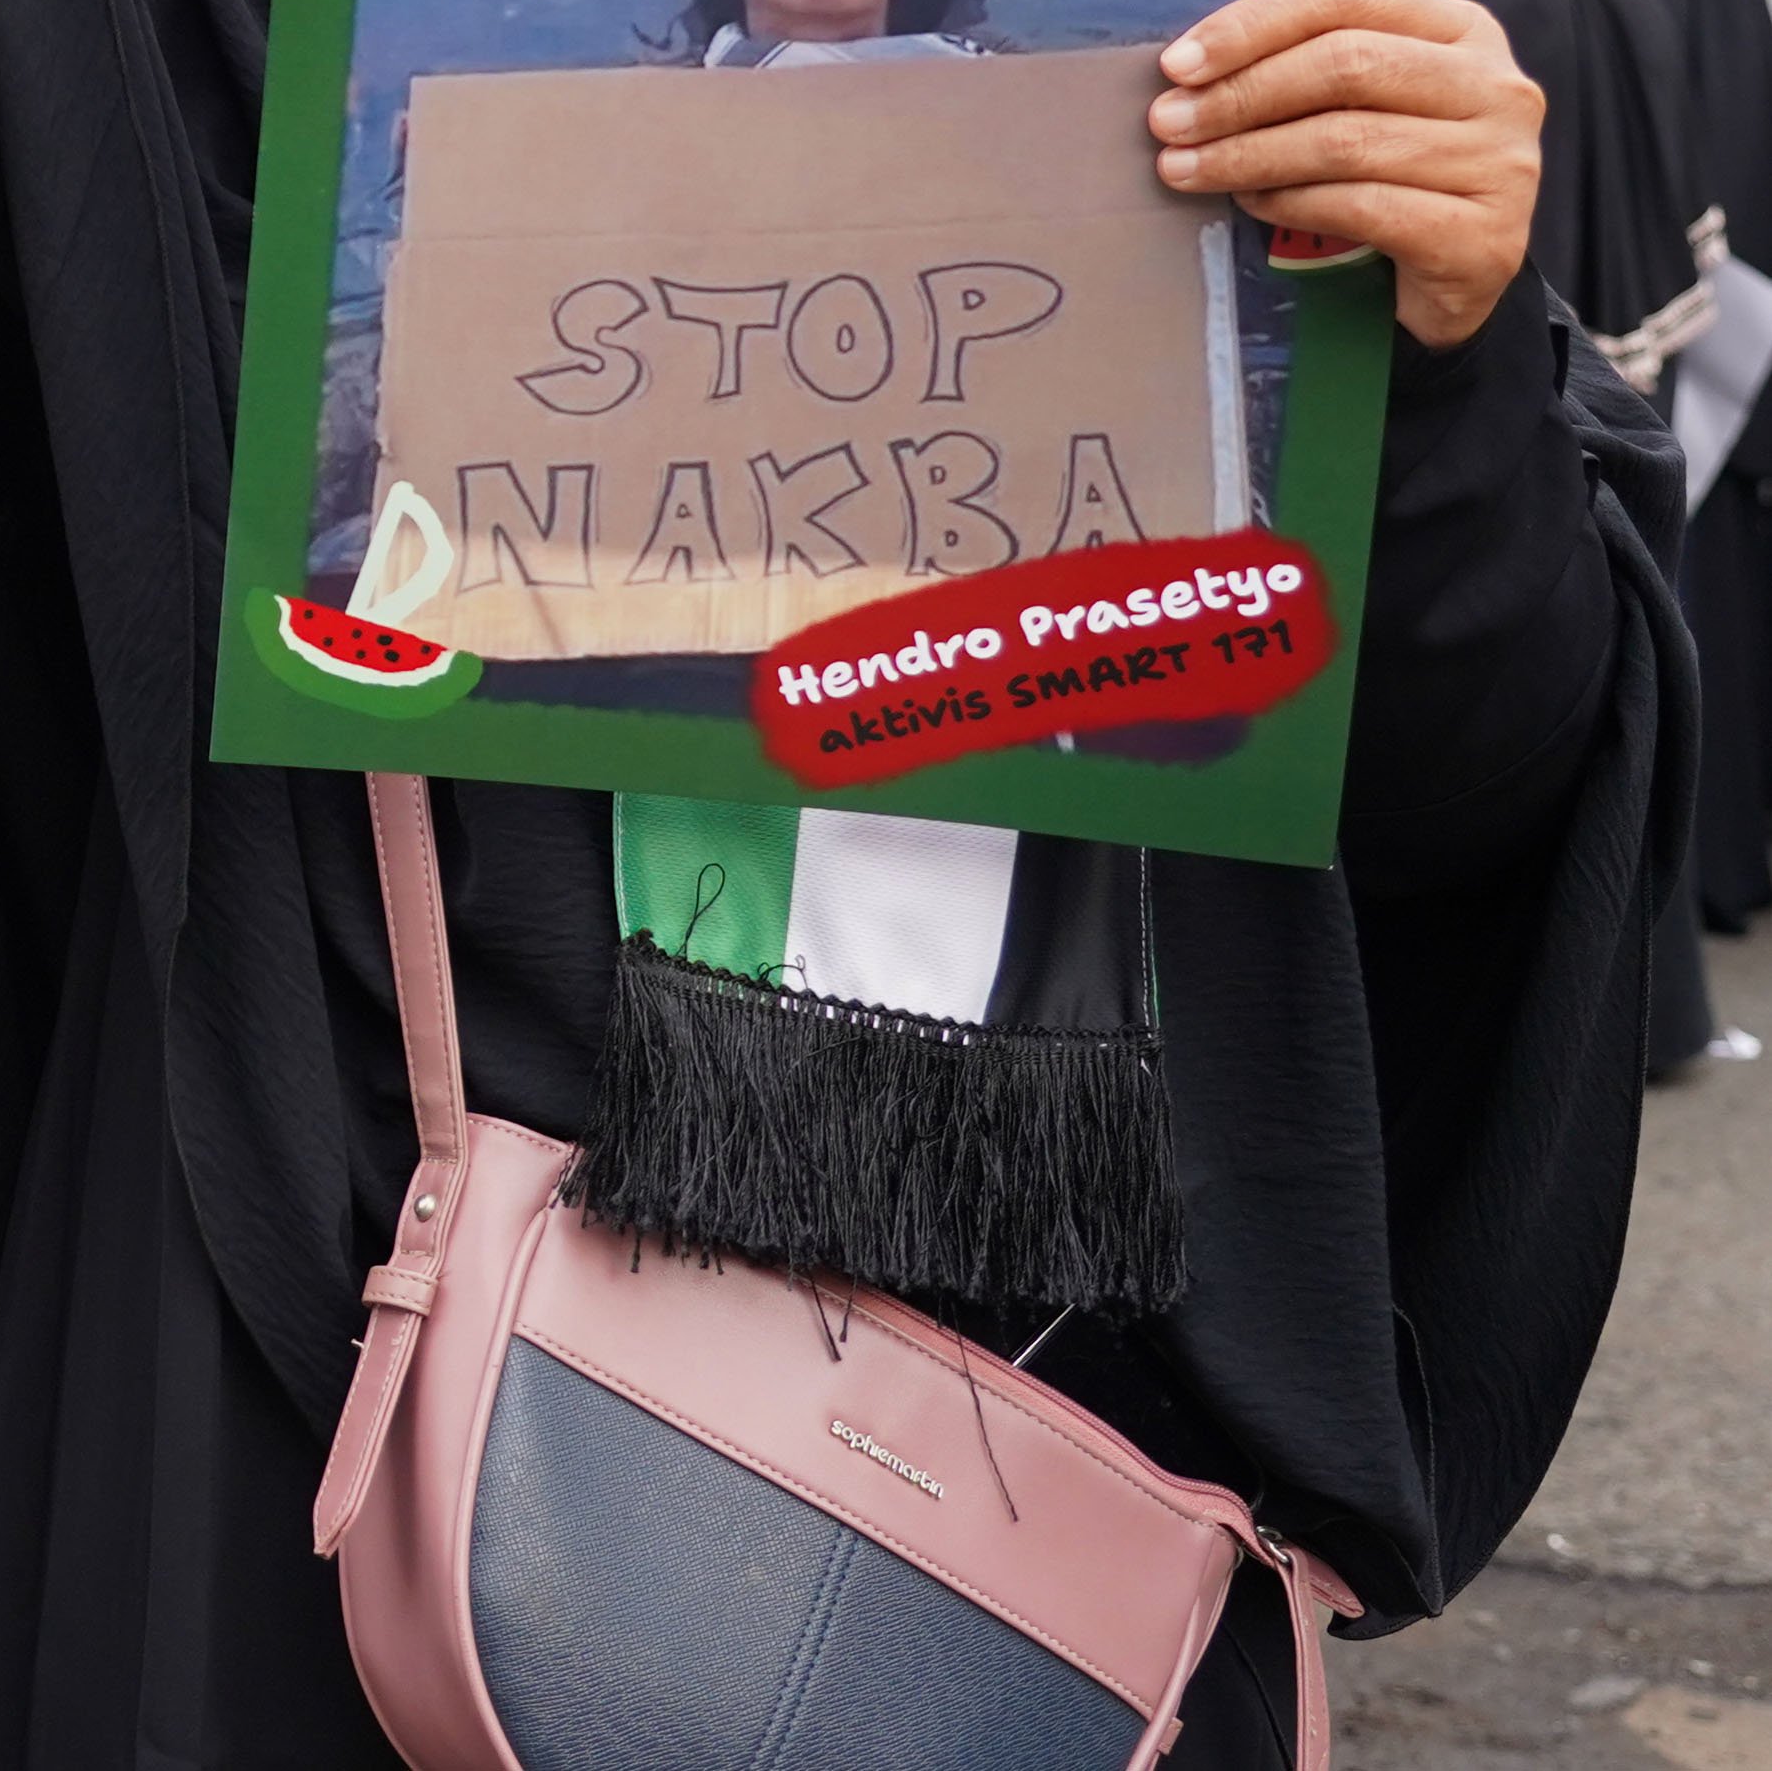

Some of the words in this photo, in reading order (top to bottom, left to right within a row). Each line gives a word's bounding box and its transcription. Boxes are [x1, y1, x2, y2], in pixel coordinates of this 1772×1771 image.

[515, 263, 1063, 416] STOP
[455, 431, 1151, 588] NAKBA
[778, 625, 1002, 705] Hendro
[1019, 563, 1302, 647] Prasetyo
[818, 686, 992, 754] aktivis
[1006, 643, 1190, 709] SMART
[1212, 619, 1293, 666] 171
